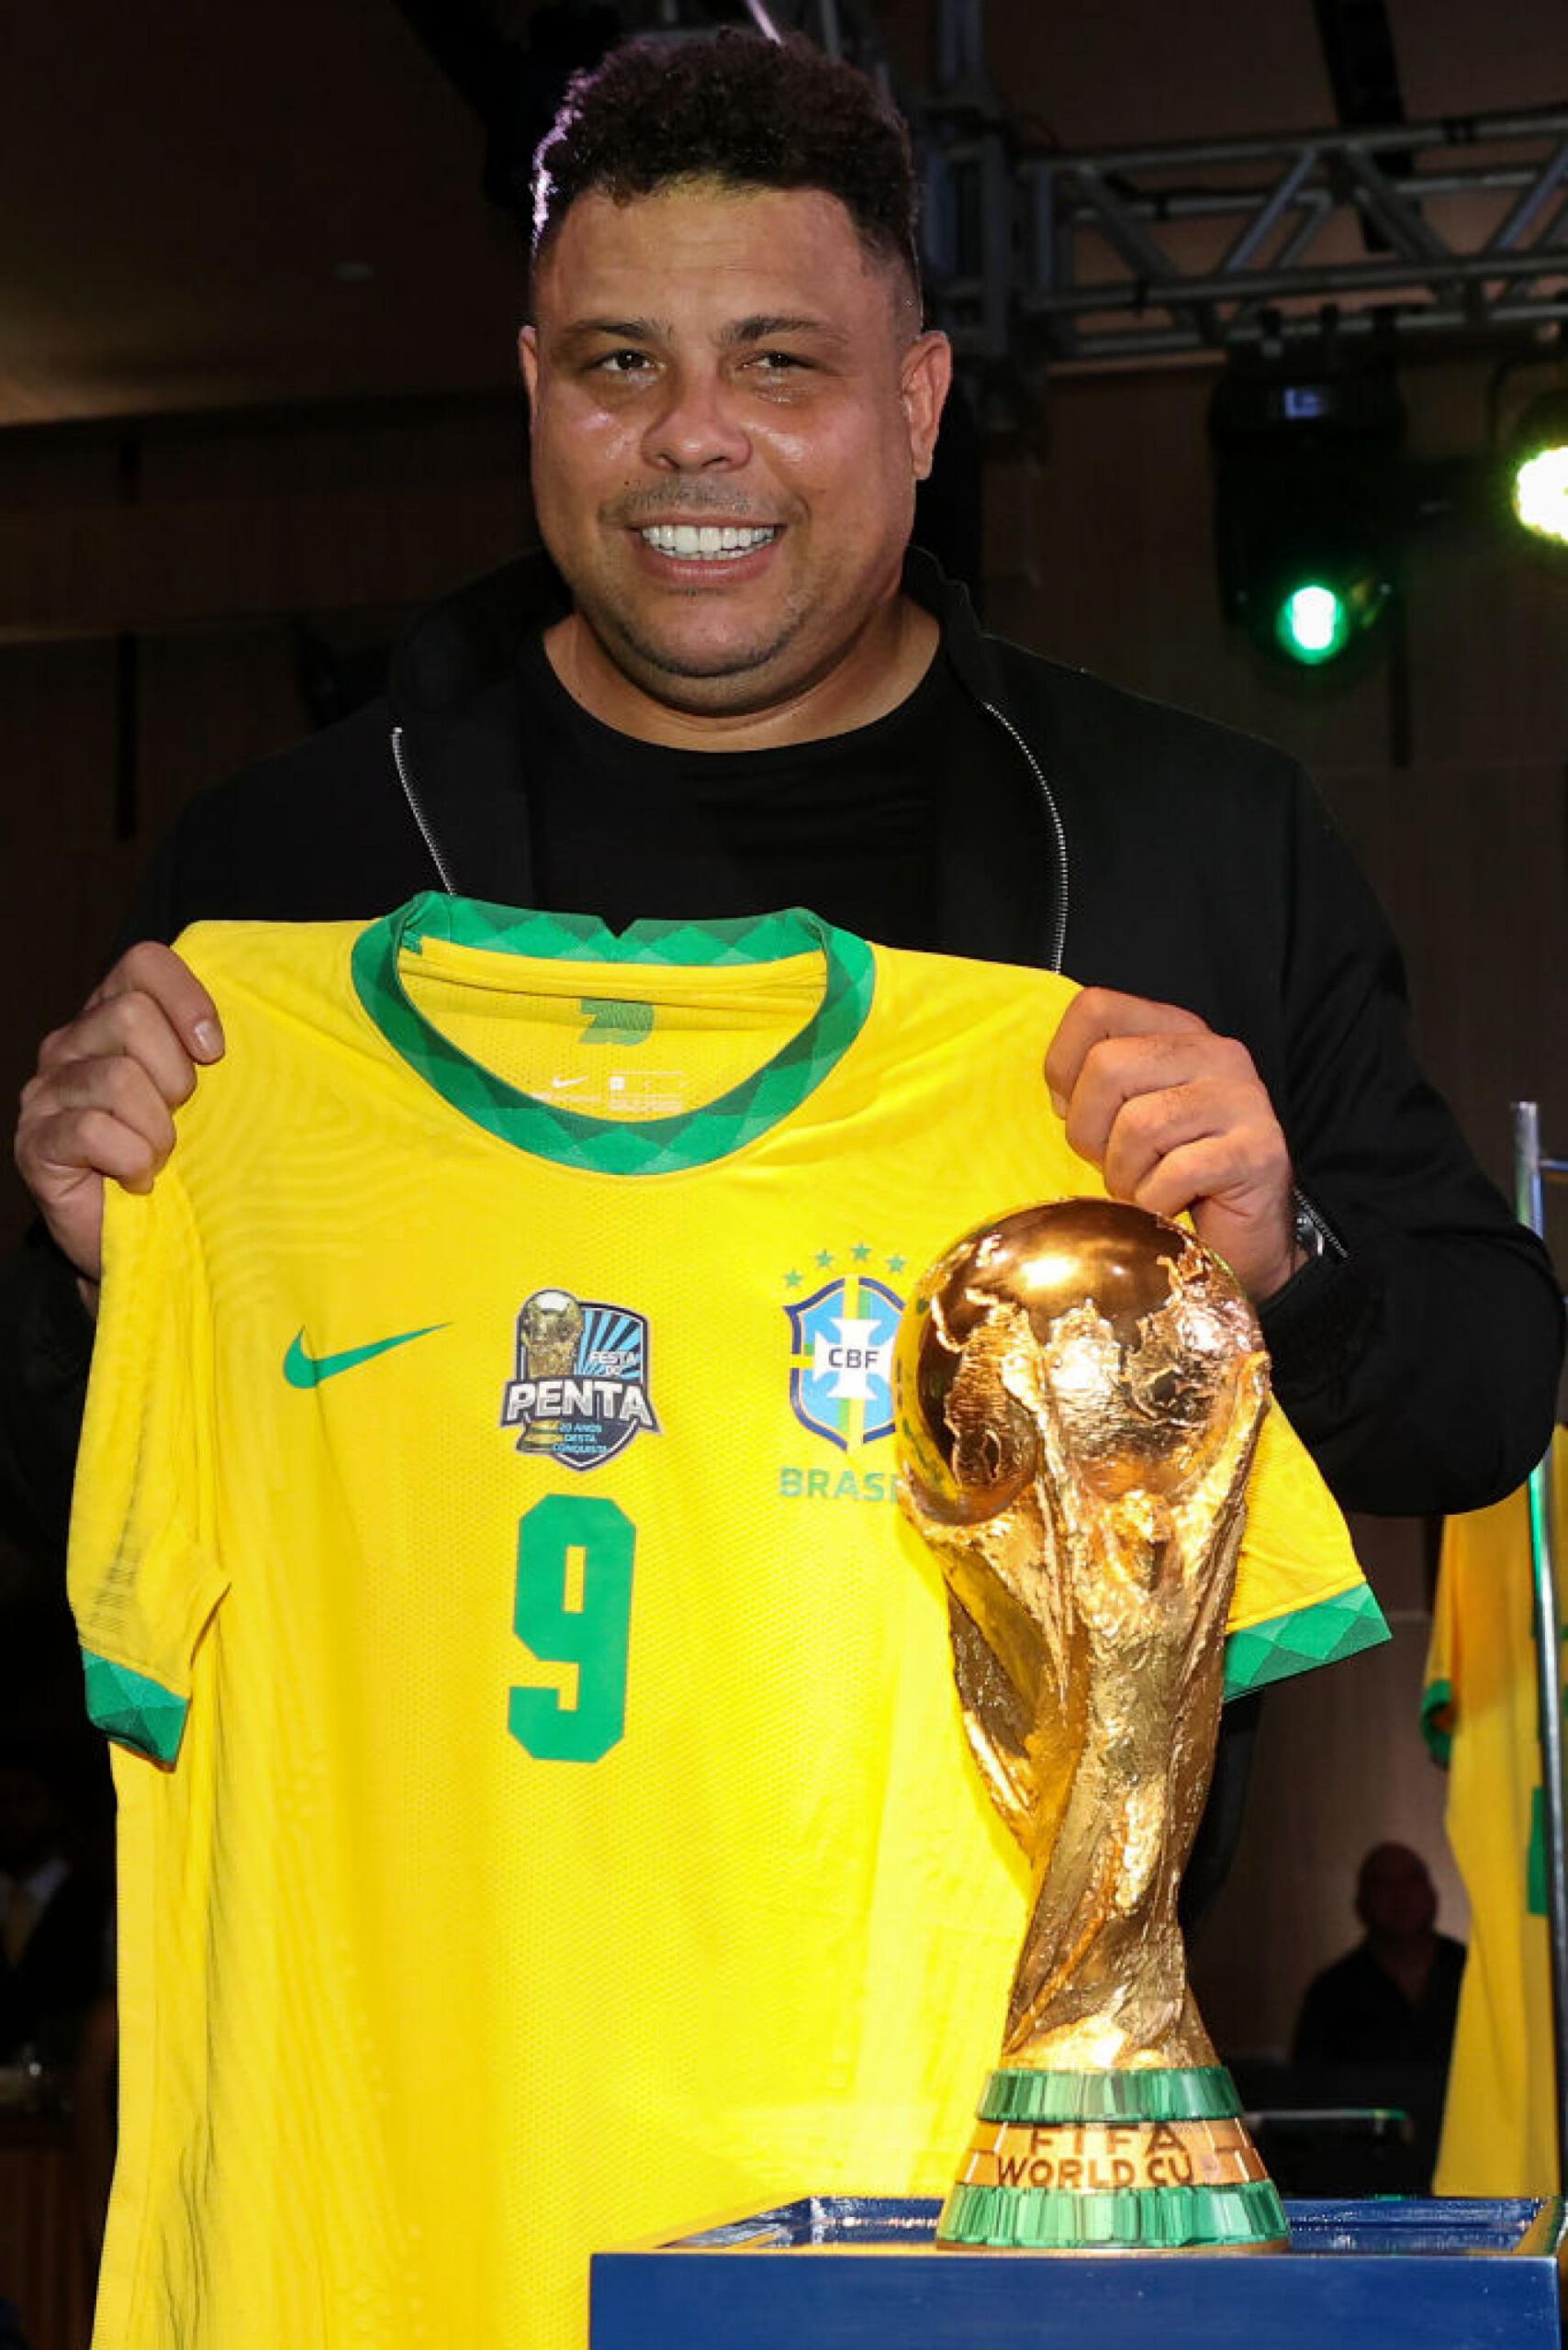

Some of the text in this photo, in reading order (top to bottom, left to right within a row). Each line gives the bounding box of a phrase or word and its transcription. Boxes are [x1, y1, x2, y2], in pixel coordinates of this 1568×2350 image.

[589, 1351, 636, 1365] FESTA
[828, 1348, 879, 1369] CBF
[507, 1379, 653, 1426] PENTA
[779, 1467, 898, 1504] BRASI
[507, 1493, 636, 1762] 9
[1030, 2121, 1189, 2157] FIFA
[999, 2153, 1193, 2188] WORLD CU
